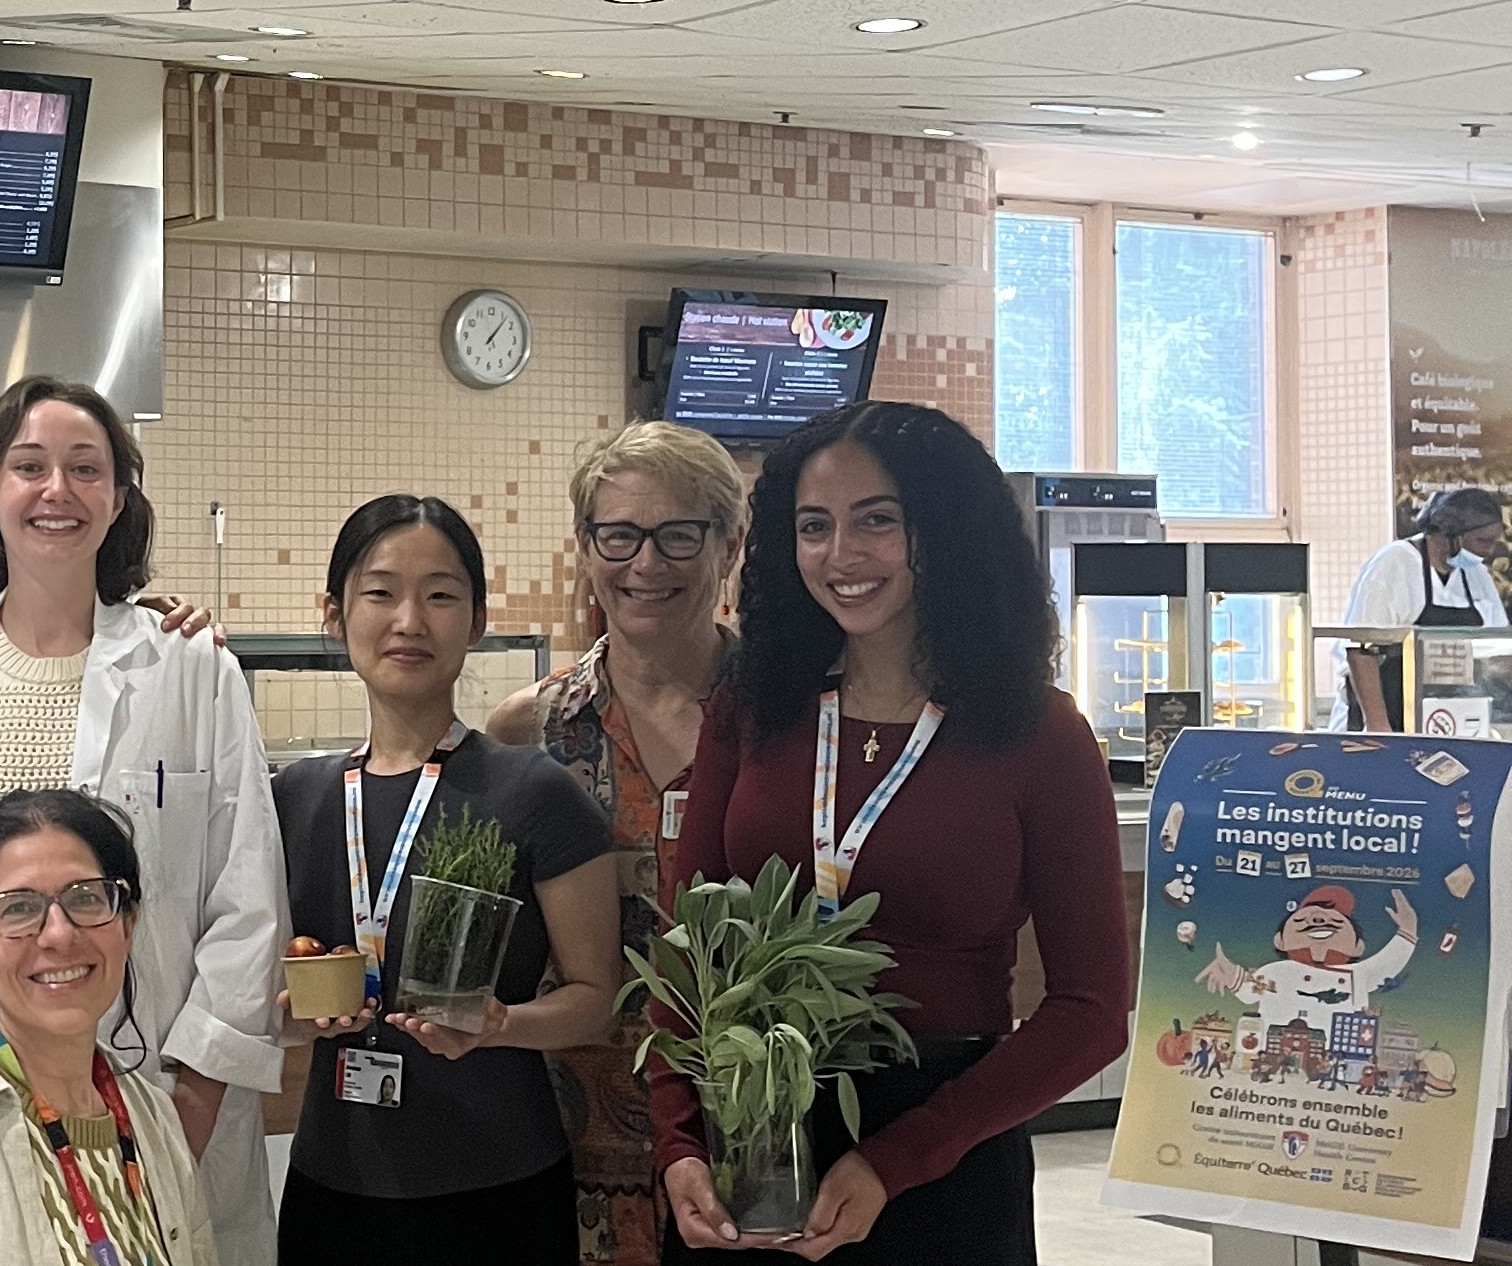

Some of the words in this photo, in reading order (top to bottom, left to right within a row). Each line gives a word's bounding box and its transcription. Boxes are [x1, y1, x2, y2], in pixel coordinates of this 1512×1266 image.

[1325, 790, 1366, 800] MENU
[1216, 801, 1260, 821] Les
[1267, 802, 1424, 830] institutions
[1216, 827, 1336, 852] mangent
[1240, 858, 1258, 872] 21
[1289, 861, 1307, 874] 27
[1316, 864, 1384, 876] septembre
[1210, 1086, 1298, 1108] Célébrons
[1303, 1100, 1388, 1120] ensemble
[1191, 1101, 1214, 1116] les
[1219, 1106, 1294, 1126] aliments
[1299, 1116, 1320, 1130] du
[1326, 1118, 1404, 1140] Québec!
[1258, 1162, 1308, 1180] Québec
